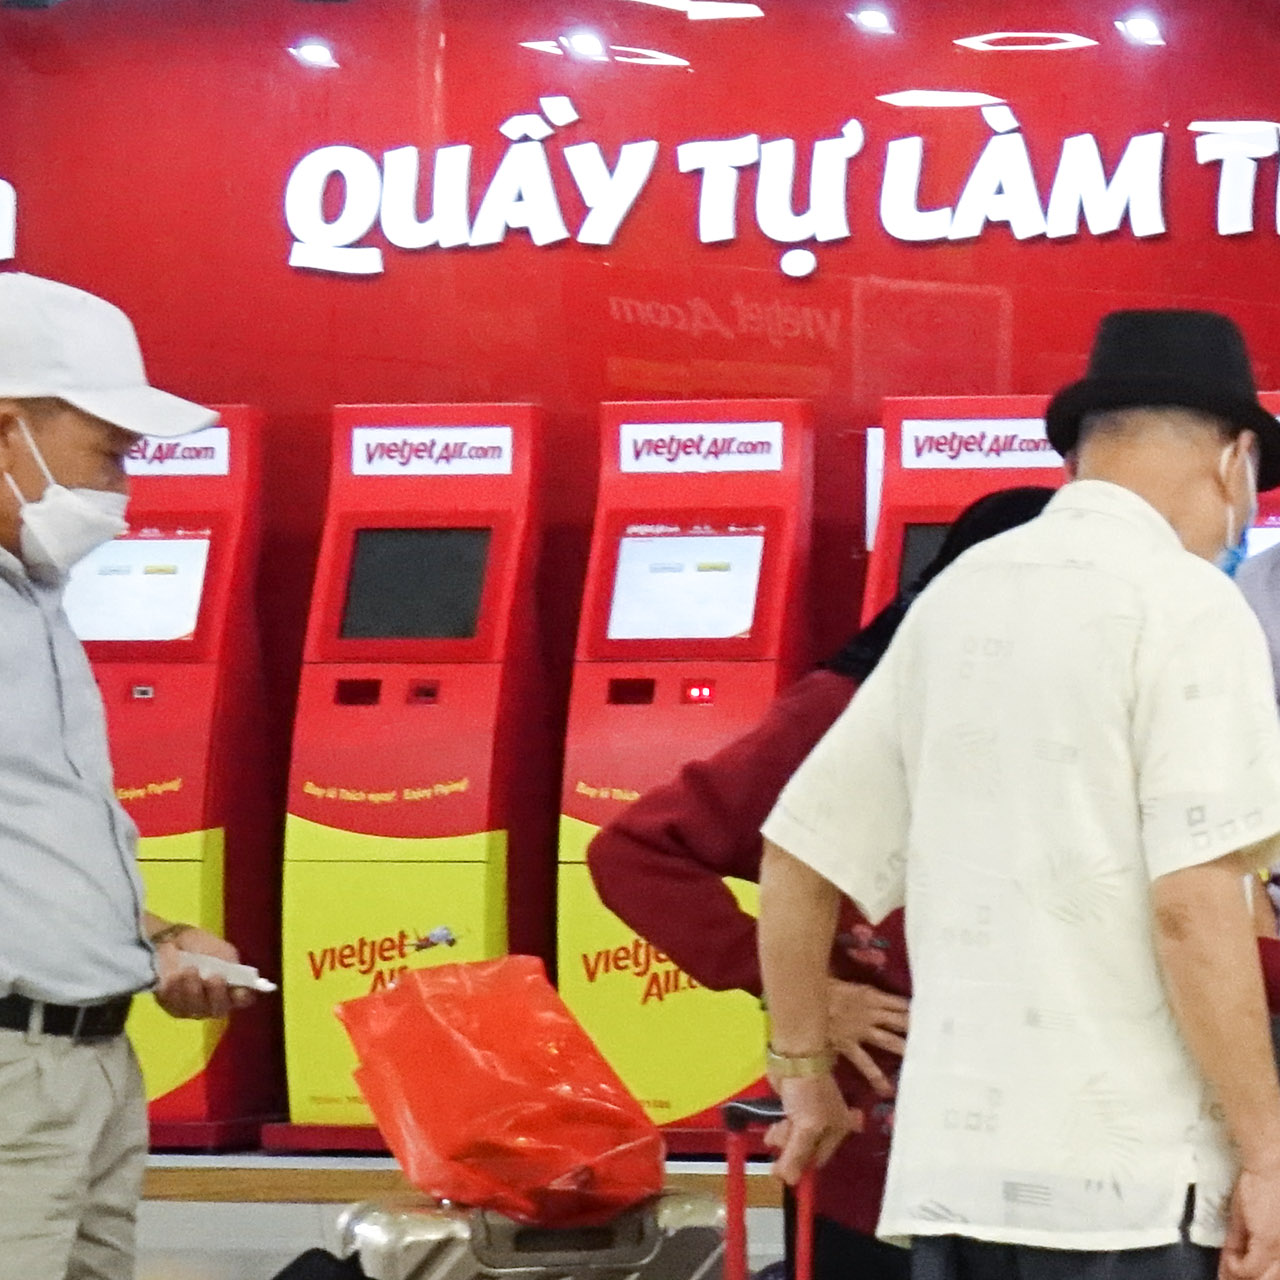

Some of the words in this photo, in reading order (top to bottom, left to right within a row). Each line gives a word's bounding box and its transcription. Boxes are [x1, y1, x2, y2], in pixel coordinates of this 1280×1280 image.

[285, 96, 658, 274] QUẦY
[677, 119, 864, 277] TỰ
[880, 106, 1165, 240] LÀM
